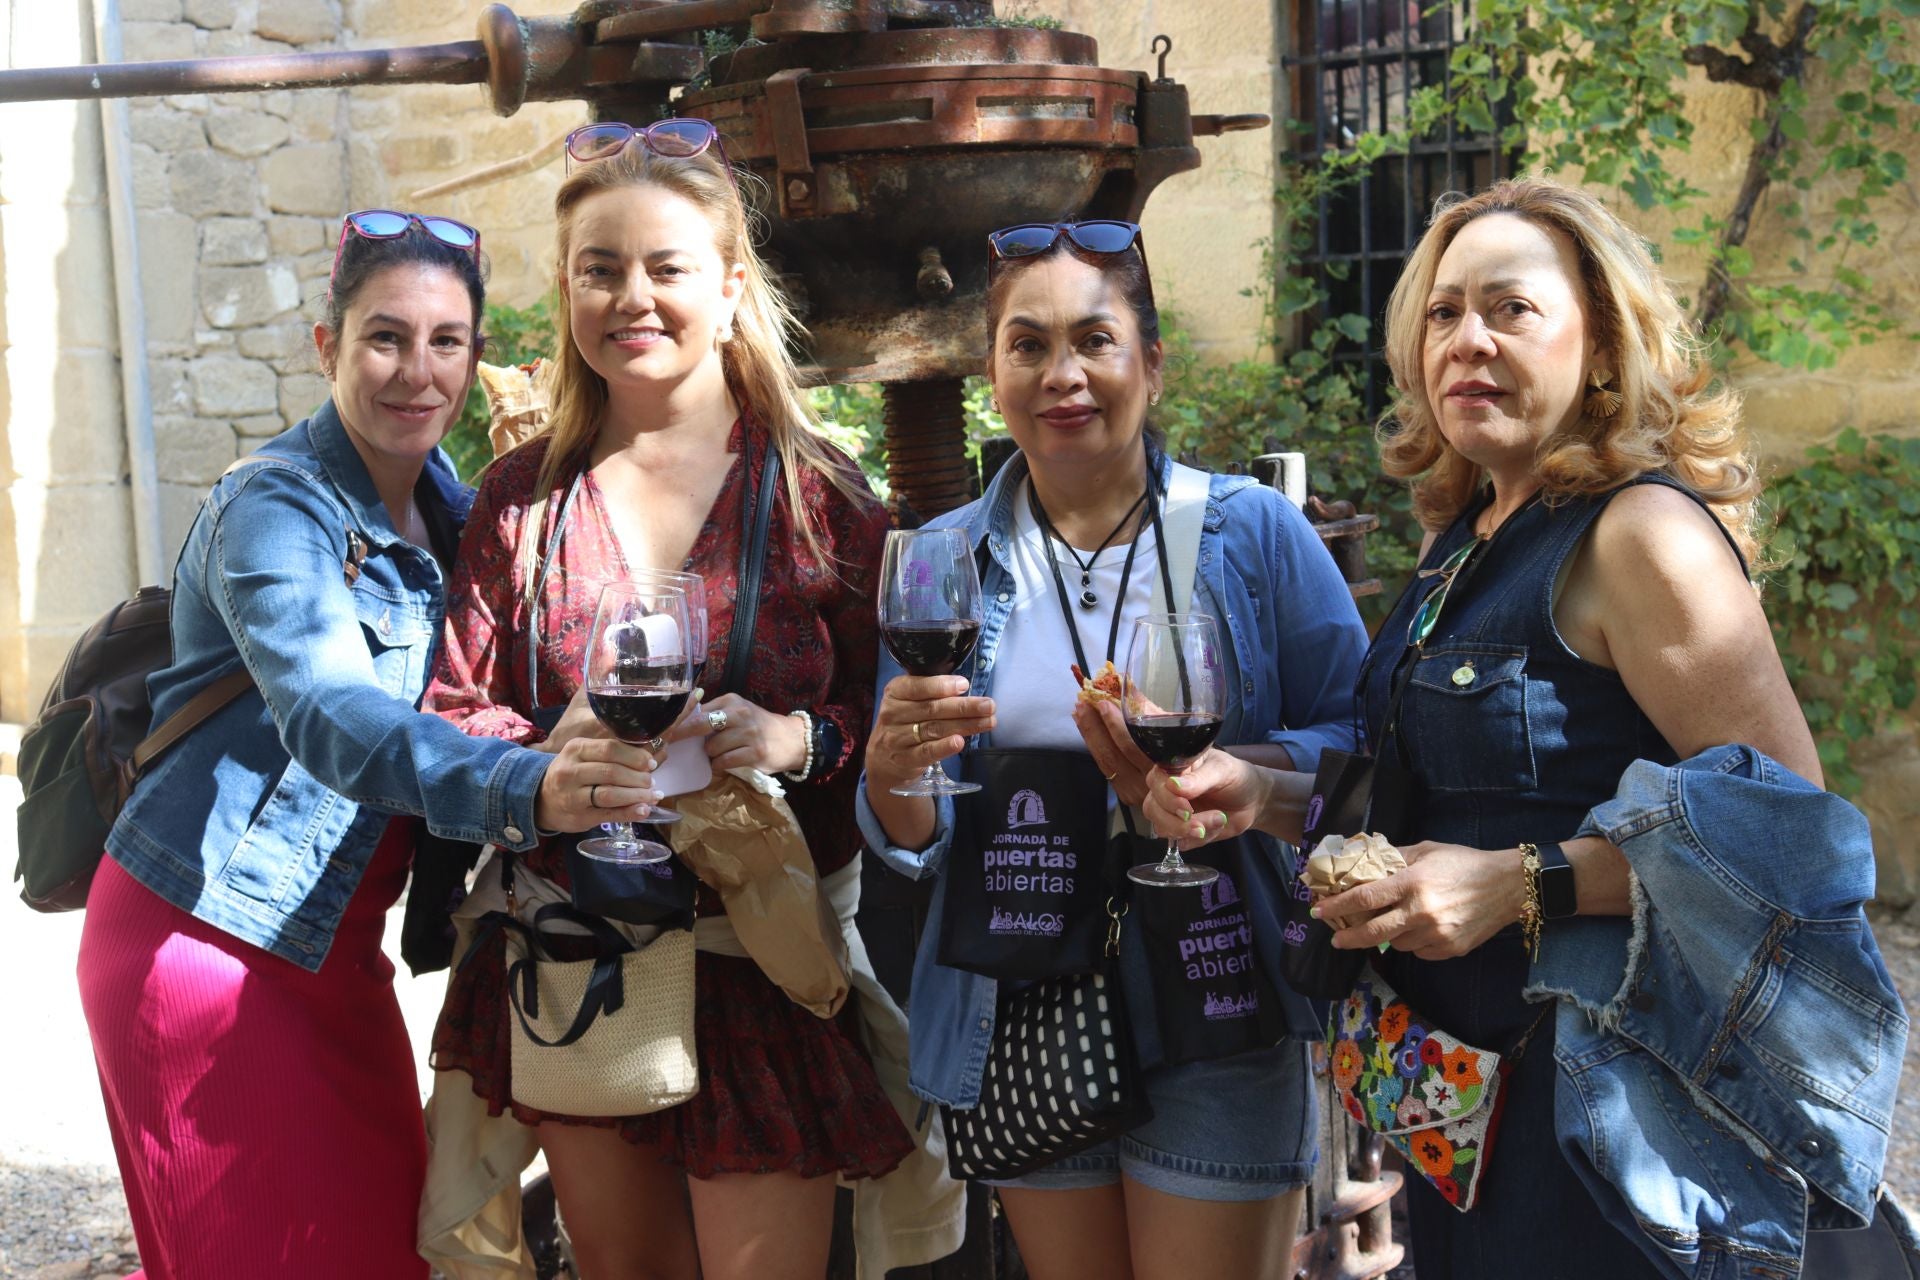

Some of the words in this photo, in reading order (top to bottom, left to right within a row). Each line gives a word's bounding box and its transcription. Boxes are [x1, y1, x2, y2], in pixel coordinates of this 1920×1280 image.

[993, 833, 1047, 845] JORNADA
[1053, 835, 1070, 846] DE
[984, 846, 1077, 872] puertas
[985, 869, 1075, 894] abiertas
[1187, 912, 1245, 932] JORNADA
